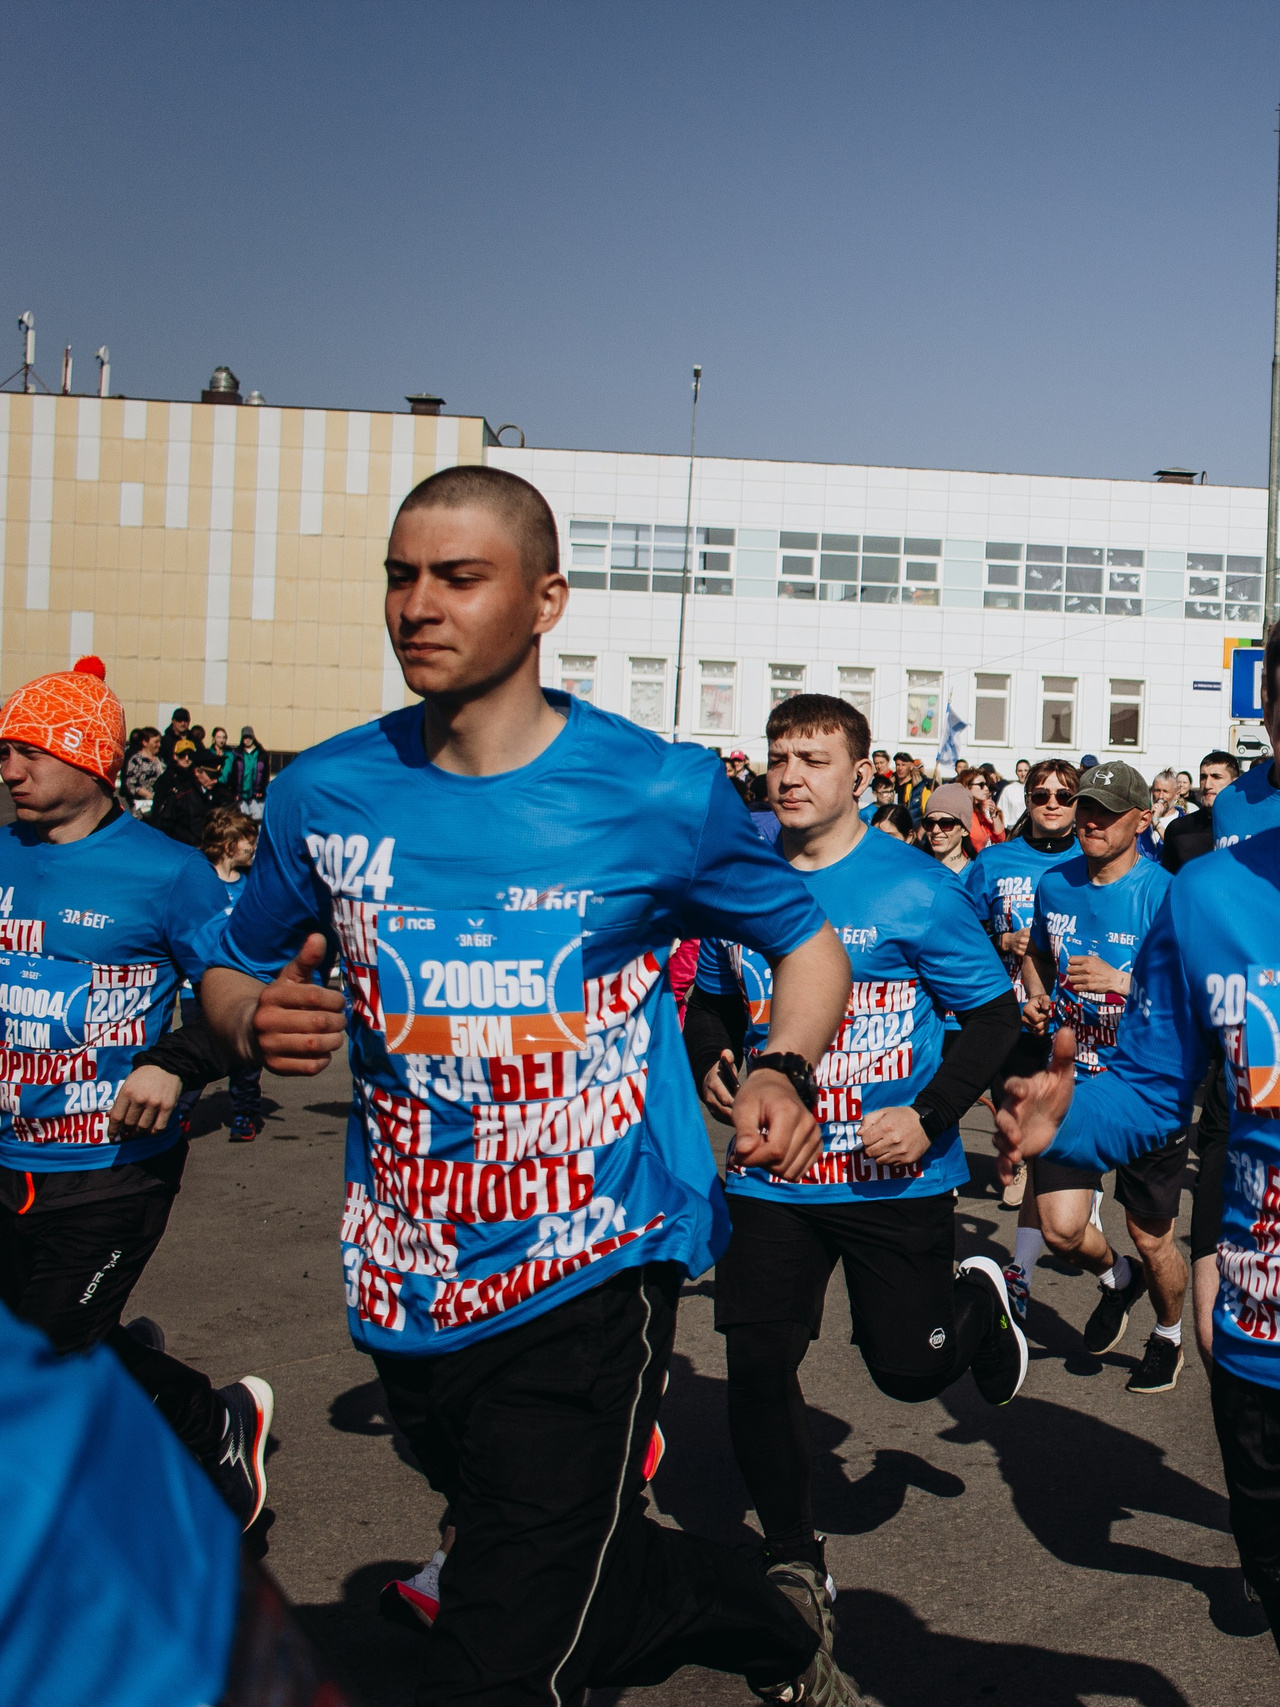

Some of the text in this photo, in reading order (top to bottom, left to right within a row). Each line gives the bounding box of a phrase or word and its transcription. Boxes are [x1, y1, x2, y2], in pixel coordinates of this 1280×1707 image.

[306, 833, 396, 900] 2024
[997, 876, 1032, 896] 2024
[1047, 912, 1077, 936] 2024
[420, 959, 546, 1009] 20055
[1206, 973, 1247, 1026] 20
[852, 1010, 915, 1051] 2024
[12, 1111, 112, 1144] #ЕДИНС
